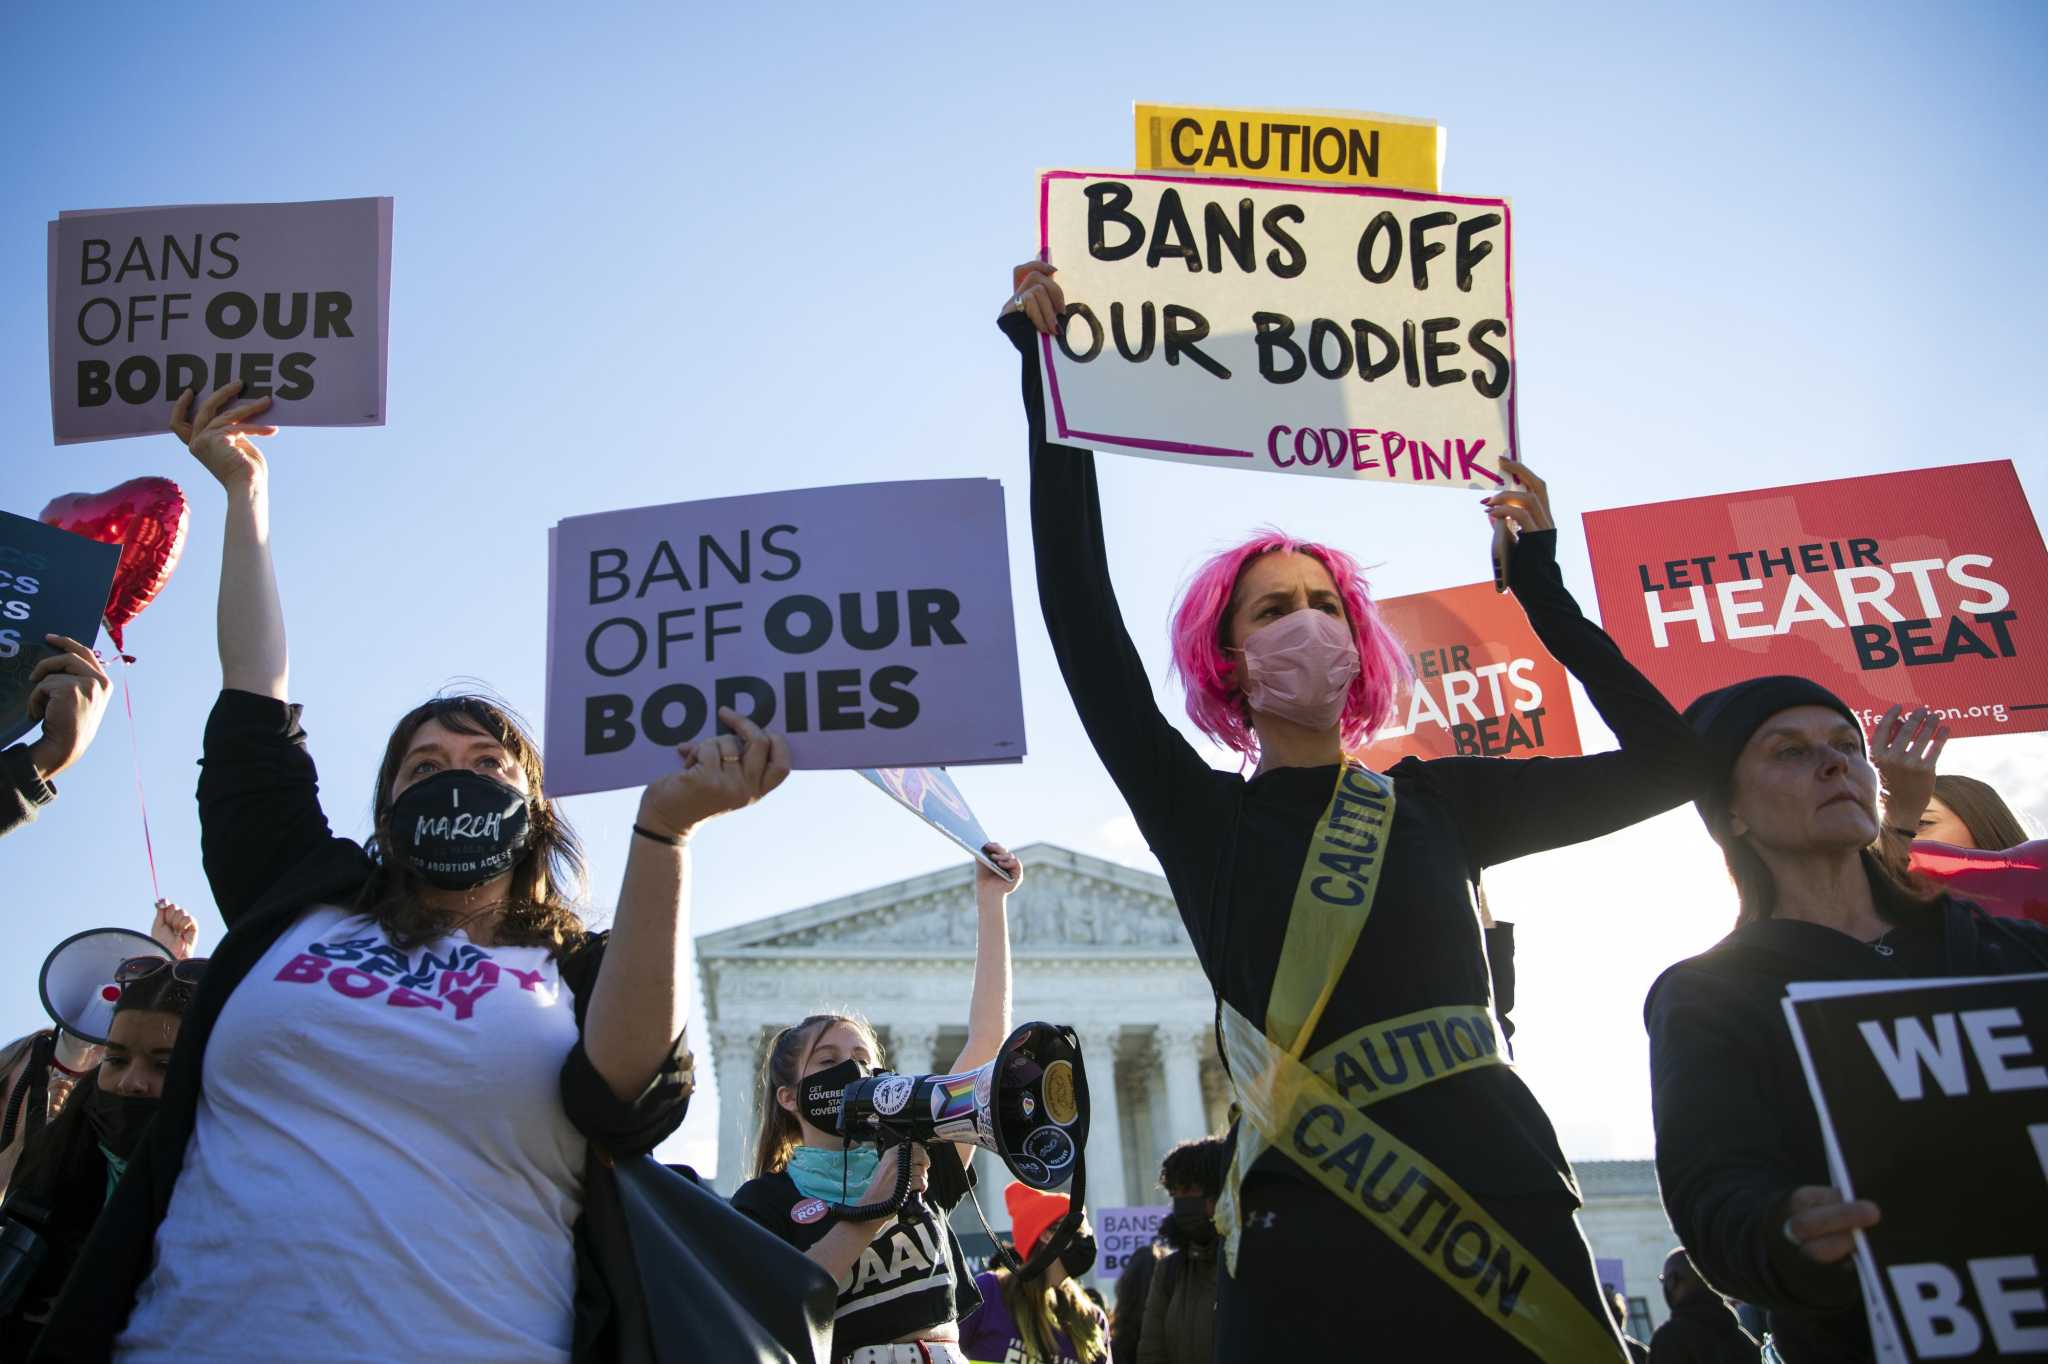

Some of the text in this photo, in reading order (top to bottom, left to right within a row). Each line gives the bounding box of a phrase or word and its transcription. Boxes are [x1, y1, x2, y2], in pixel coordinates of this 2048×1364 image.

[1170, 117, 1380, 178] CAUTION
[80, 231, 241, 285] BANS
[1083, 181, 1502, 292] BANS OFF
[77, 290, 355, 346] OFF OUR
[77, 351, 318, 408] BODIES
[1056, 301, 1512, 399] OUR BODIES
[1267, 424, 1505, 486] CODEPINK
[589, 523, 801, 605] BANS
[1638, 537, 1883, 592] LET THEIR
[1643, 553, 2011, 649] HEARTS
[584, 588, 968, 677] OFF OUR
[1409, 644, 1473, 679] EIR
[1850, 610, 2018, 671] BEAT
[584, 664, 921, 756] BODIES
[1363, 657, 1543, 745] ARTS
[1451, 707, 1547, 757] BEAT
[453, 787, 460, 808] I
[414, 812, 502, 846] MARCH
[1310, 767, 1390, 907] CAUTIO
[427, 860, 477, 873] ABORTION
[272, 952, 499, 1021] BODY
[1333, 1015, 1498, 1101] AUTION
[809, 1085, 822, 1093] GET
[810, 1105, 842, 1117] COVERE
[798, 1199, 825, 1221] ROE
[1104, 1214, 1158, 1233] BANS
[1293, 1104, 1535, 1318] CAUTION
[1104, 1234, 1146, 1253] OFF
